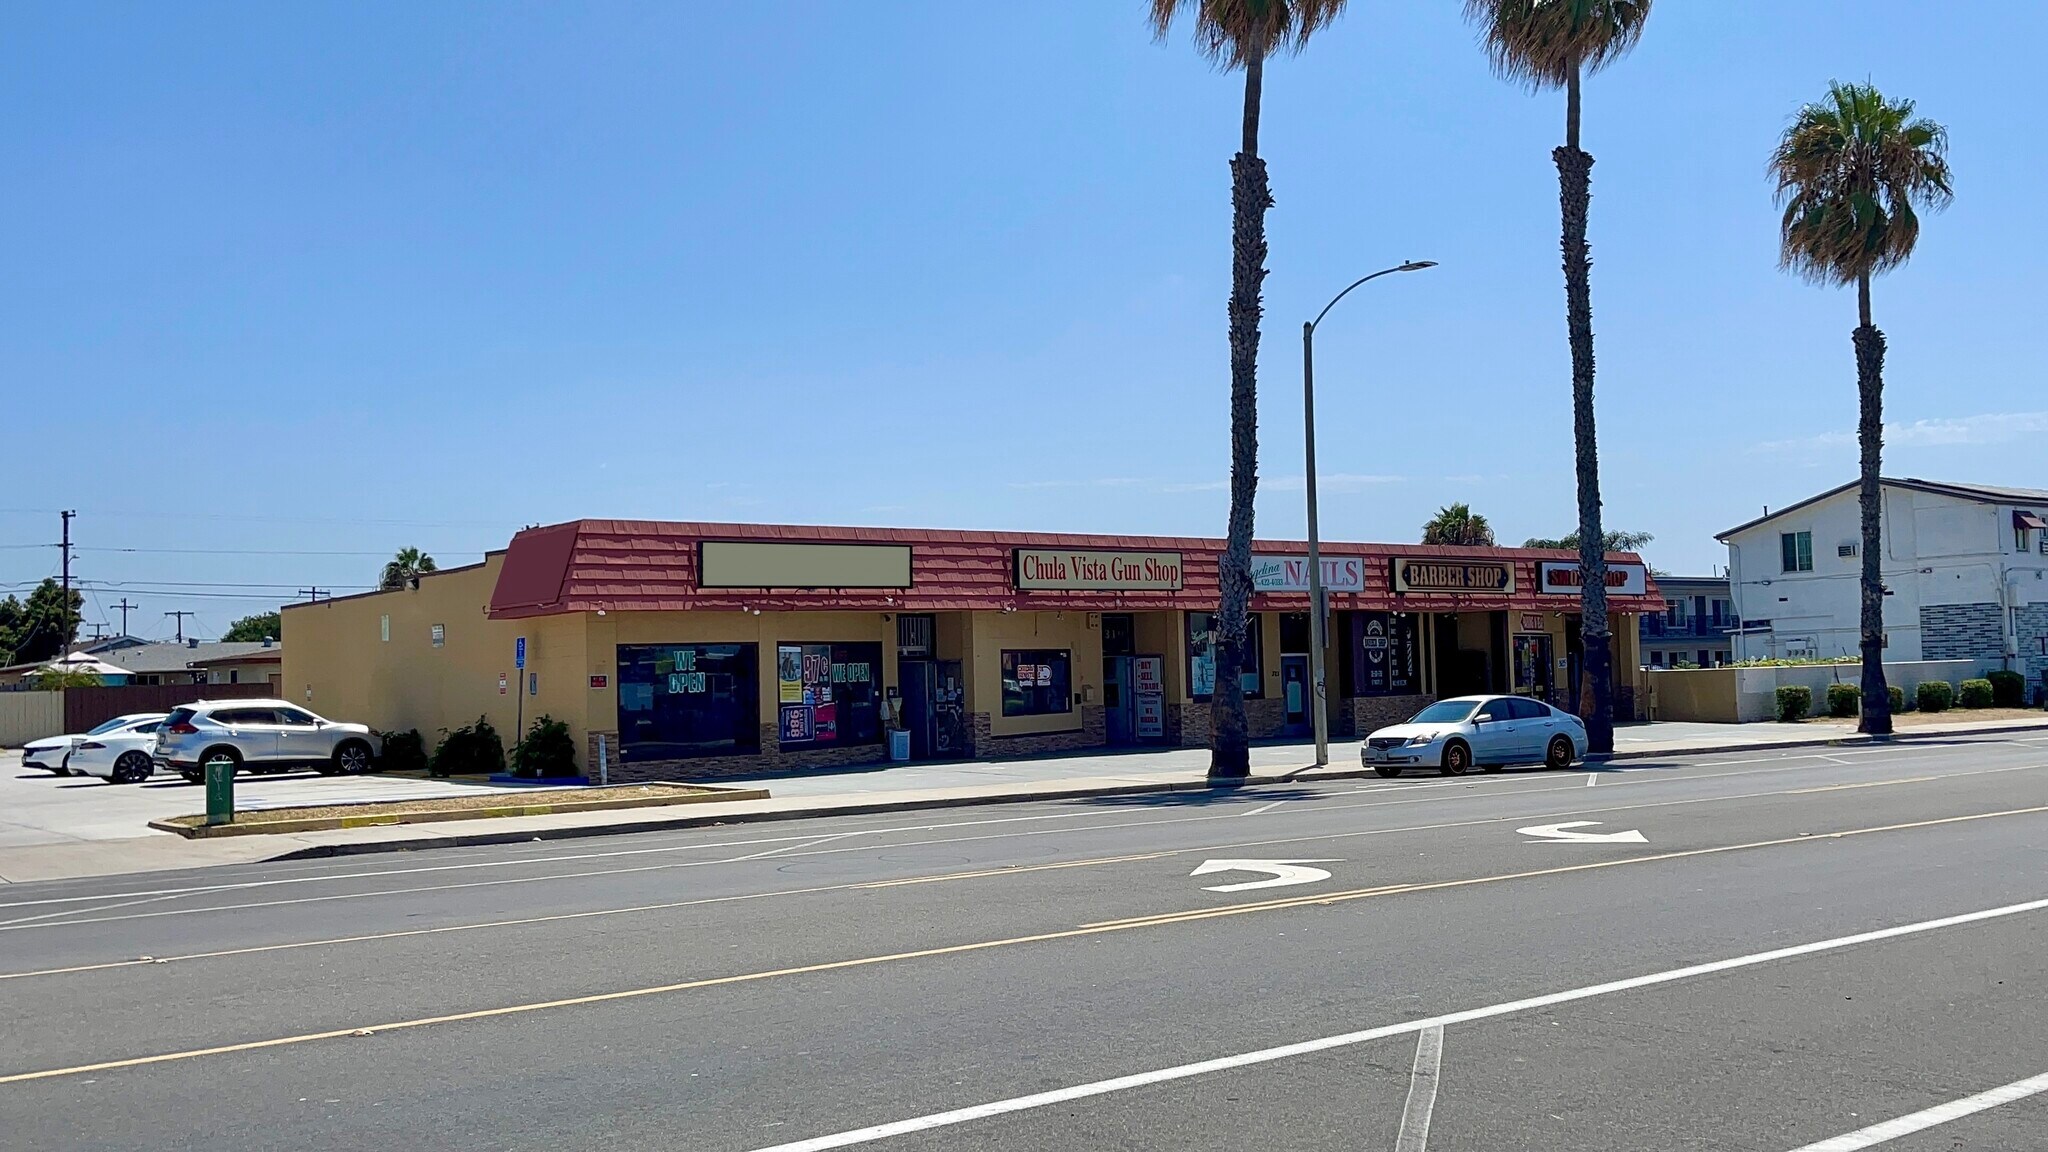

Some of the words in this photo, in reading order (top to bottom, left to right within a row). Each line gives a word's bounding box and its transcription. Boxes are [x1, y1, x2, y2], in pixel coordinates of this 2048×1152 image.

[1023, 555, 1066, 581] Chula
[1071, 556, 1107, 581] Vista
[1112, 557, 1140, 581] Gun
[1145, 557, 1178, 587] Shop
[1250, 562, 1280, 582] gelina
[1409, 565, 1464, 586] BARBER
[1467, 567, 1502, 587] SHOP
[1551, 570, 1584, 586] SMO
[1605, 571, 1627, 587] HOP
[673, 651, 696, 671] WE
[669, 672, 706, 693] OPEN
[832, 663, 846, 683] WE
[848, 663, 870, 683] OPEN
[790, 710, 800, 737] 988
